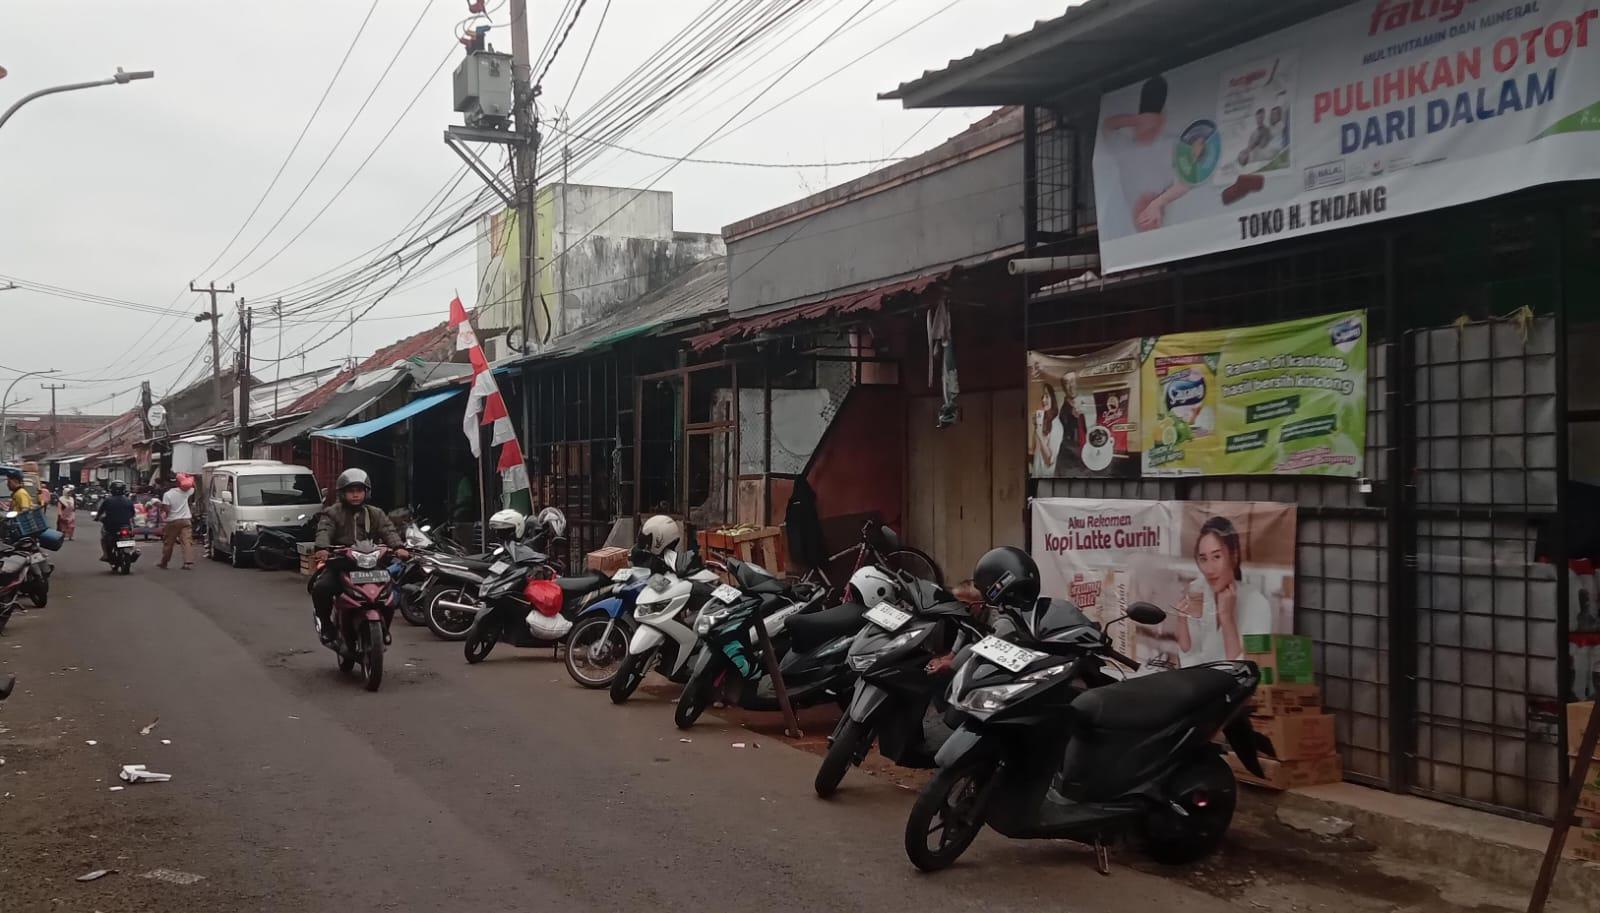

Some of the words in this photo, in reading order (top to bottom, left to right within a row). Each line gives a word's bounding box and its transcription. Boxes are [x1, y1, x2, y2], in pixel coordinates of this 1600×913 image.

[1363, 32, 1447, 65] MULTIVITAMIN
[1450, 20, 1476, 38] DAN
[1480, 1, 1539, 28] MINERAL
[1313, 47, 1482, 123] PULIHKAN
[1492, 9, 1599, 73] OTOT
[1341, 105, 1416, 154] DARI
[1427, 68, 1558, 133] DALAM
[1238, 208, 1284, 239] TOKO
[1289, 204, 1306, 230] H.
[1310, 185, 1387, 226] ENDANG
[1222, 378, 1252, 397] hasil
[1253, 374, 1294, 391] bersih
[1226, 358, 1269, 377] Ramah
[1271, 353, 1286, 371] di
[1045, 531, 1073, 555] Kopi
[1075, 530, 1111, 550] Latte
[1114, 525, 1160, 549] Gurih!
[1068, 516, 1085, 529] Aku
[1087, 514, 1131, 528] Rekomen
